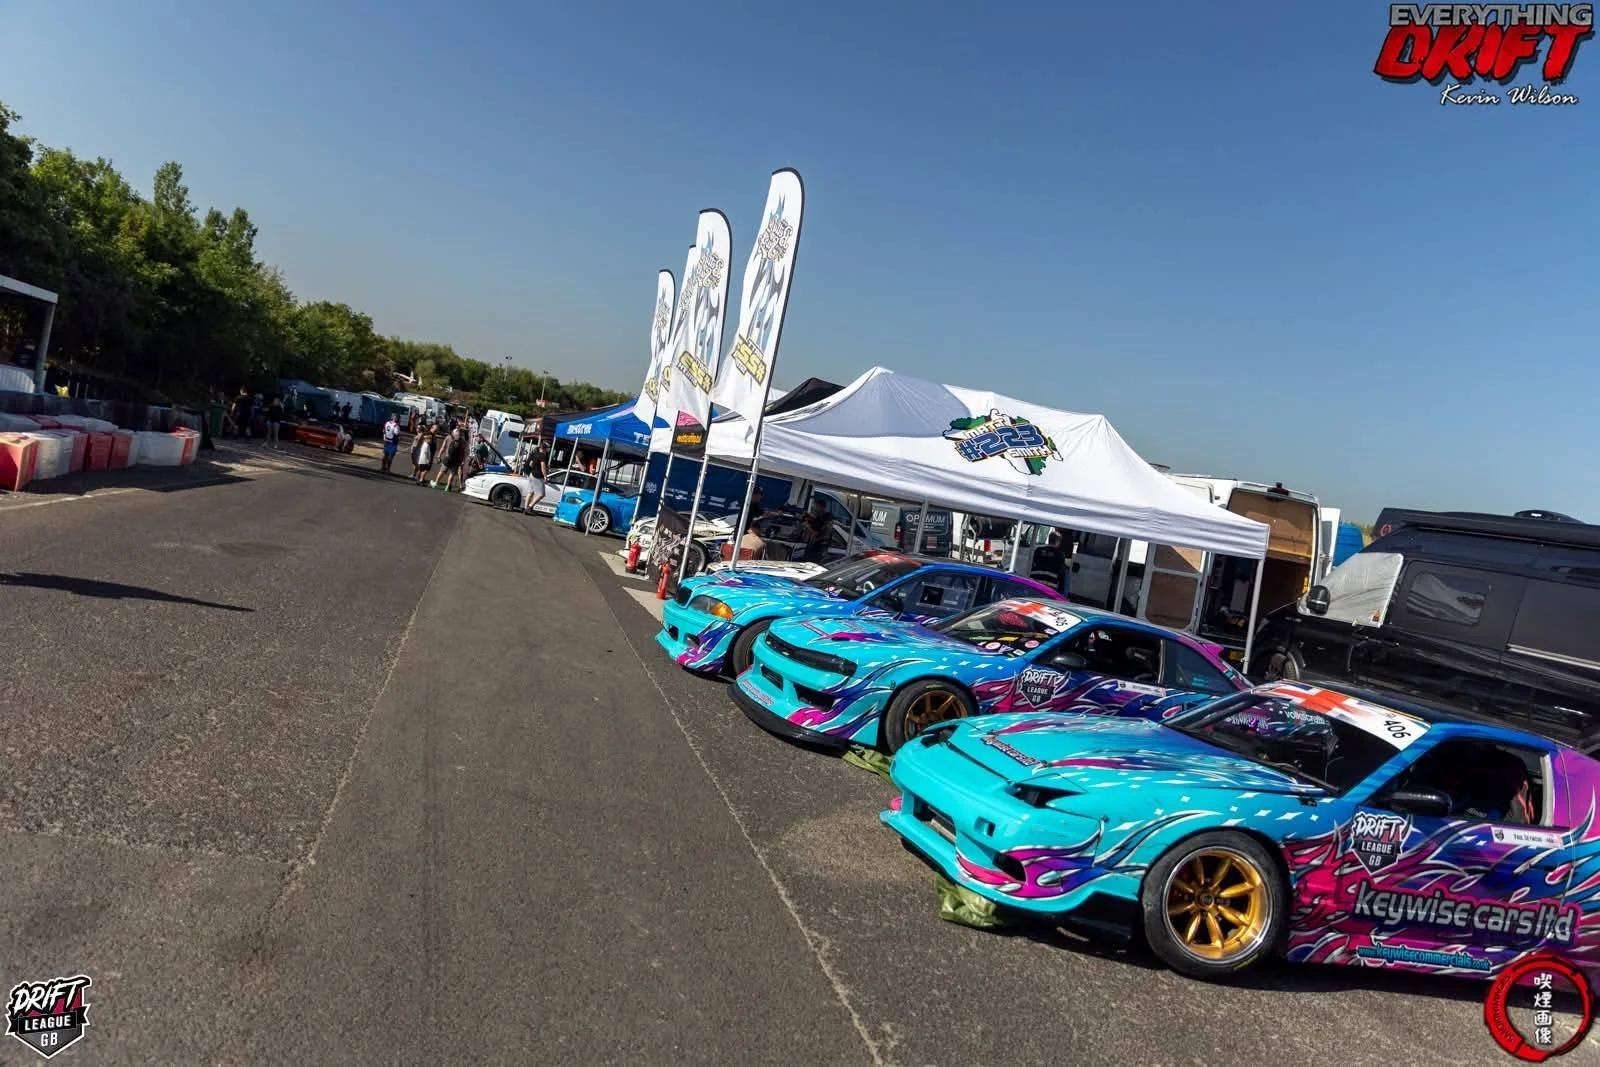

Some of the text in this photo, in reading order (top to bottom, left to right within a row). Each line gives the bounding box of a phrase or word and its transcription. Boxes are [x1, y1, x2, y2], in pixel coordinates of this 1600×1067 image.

[1024, 670, 1057, 685] DRIFT
[1027, 686, 1049, 695] LEAGUE
[1384, 720, 1411, 739] 406
[1355, 816, 1402, 839] DRIFT
[1361, 841, 1393, 855] LEAGUE
[1368, 855, 1382, 866] GB
[1355, 881, 1575, 942] keywise cars ltd
